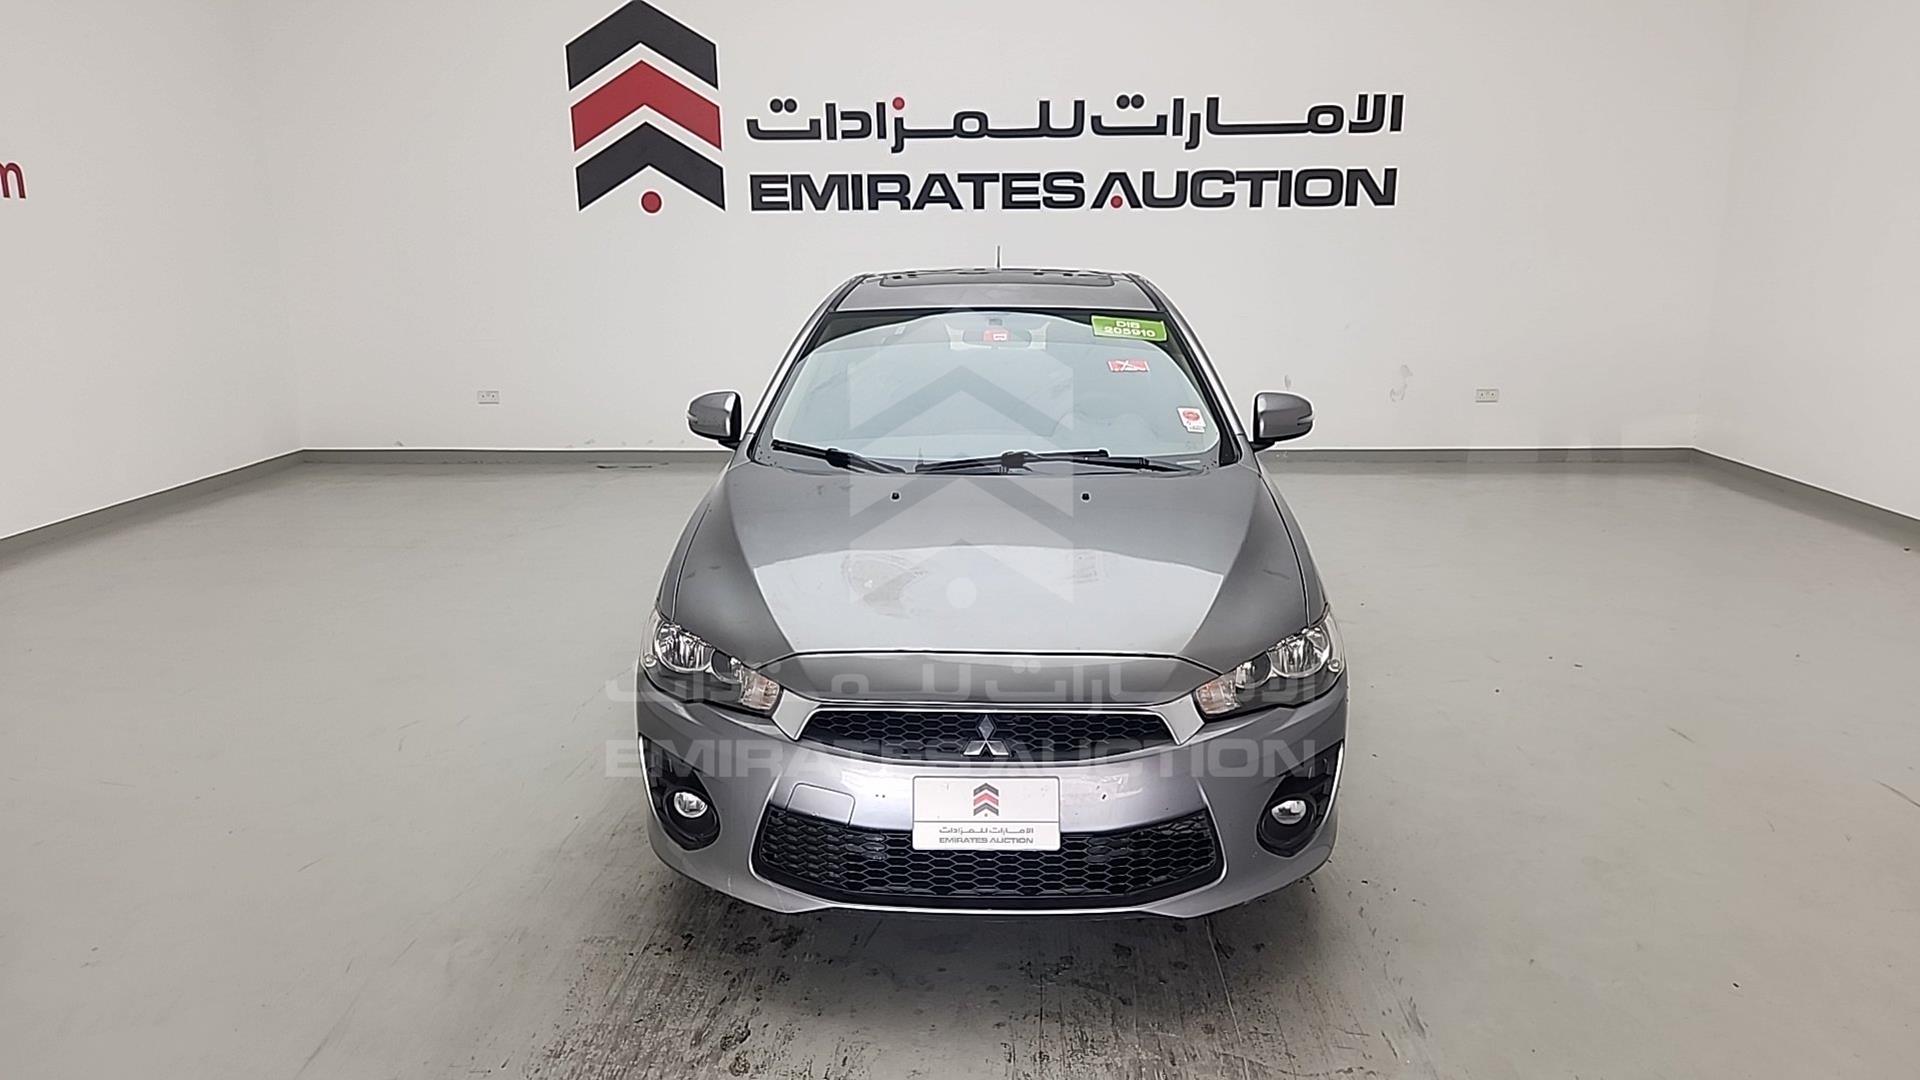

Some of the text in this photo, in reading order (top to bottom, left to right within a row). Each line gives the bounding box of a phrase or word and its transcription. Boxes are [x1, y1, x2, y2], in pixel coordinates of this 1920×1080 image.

[746, 95, 1085, 153] للمزادات
[749, 167, 1397, 211] EMIRATES AUCTION
